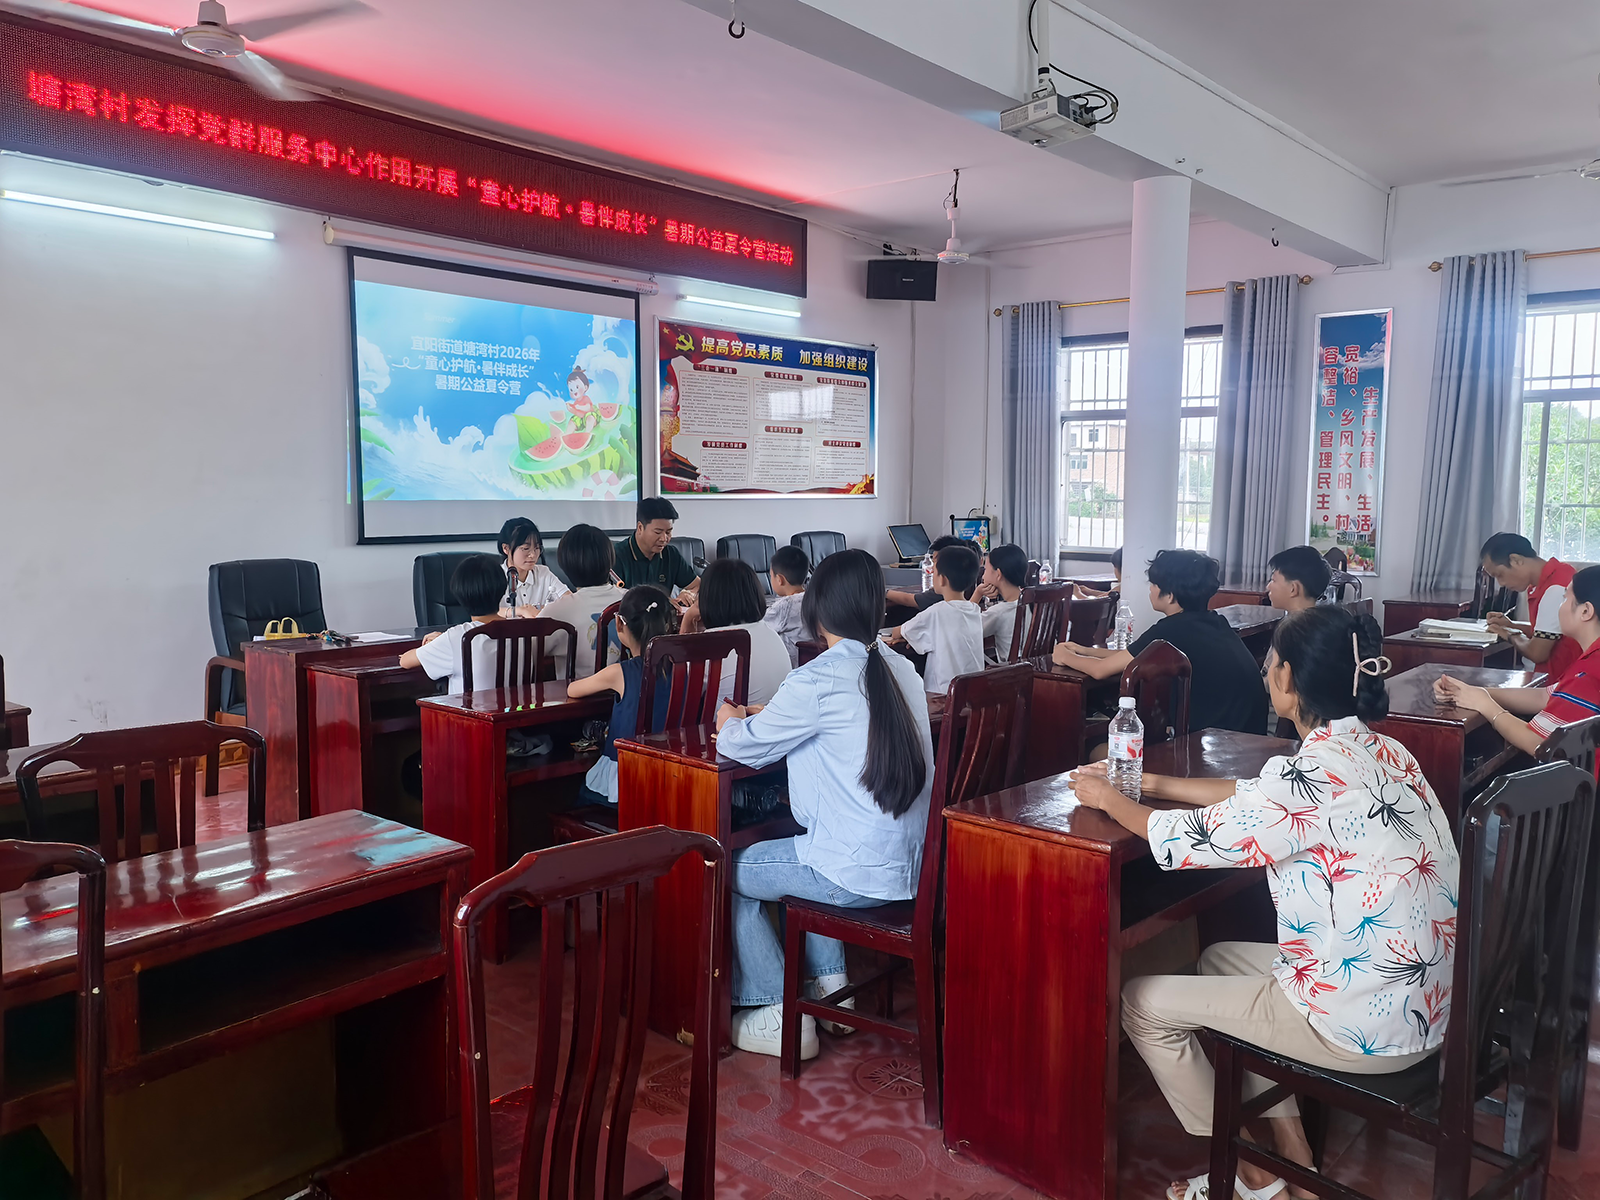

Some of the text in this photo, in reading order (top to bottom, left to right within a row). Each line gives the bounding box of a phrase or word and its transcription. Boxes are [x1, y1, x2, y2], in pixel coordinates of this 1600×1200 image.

[411, 335, 540, 362] 宜阳街道塘湾村2026年
[435, 374, 522, 396] 暑期公益夏令营
[701, 336, 868, 372] 提高党员素质 加强组织建设
[1316, 345, 1340, 524] 容整洁、管理民主。
[1335, 344, 1361, 532] 宽裕、乡风文明、村
[1356, 386, 1380, 532] 生产发展、生活
